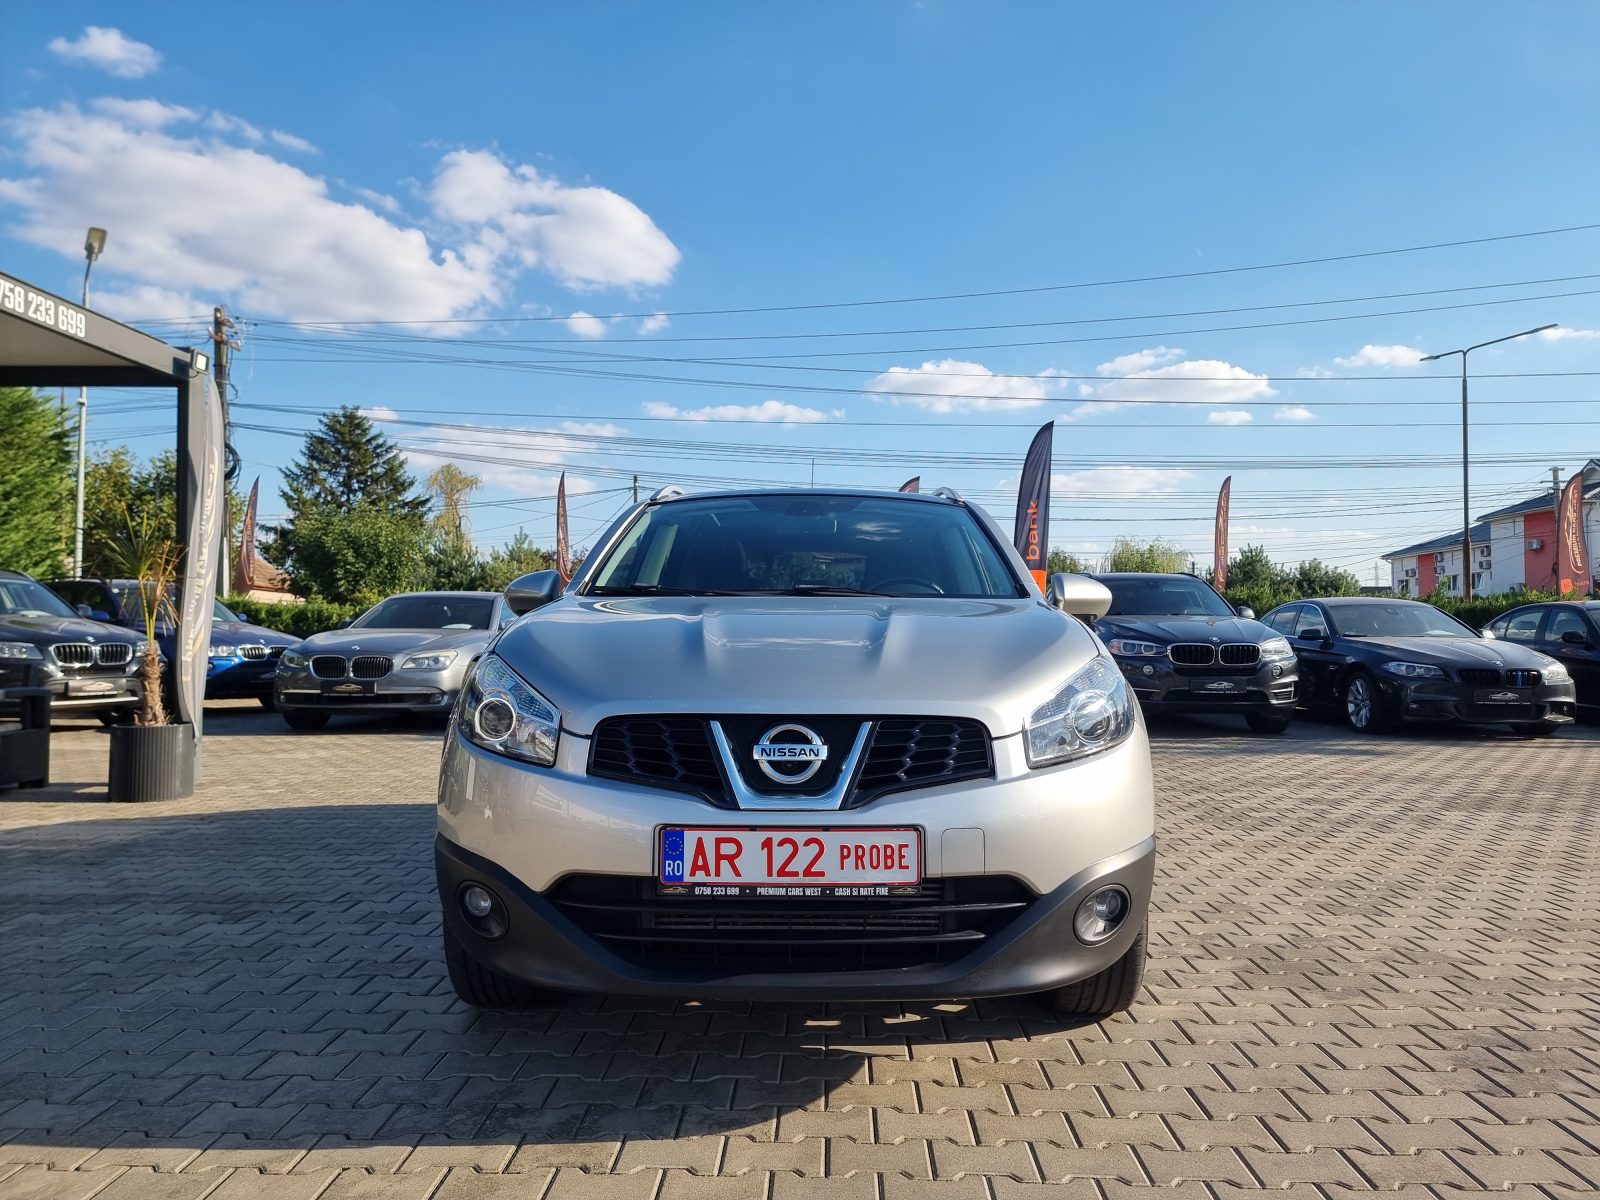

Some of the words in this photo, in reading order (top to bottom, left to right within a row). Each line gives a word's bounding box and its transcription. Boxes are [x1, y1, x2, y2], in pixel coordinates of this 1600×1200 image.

[28, 292, 55, 326] 233
[58, 305, 86, 338] 699
[1026, 499, 1040, 560] bank
[1572, 533, 1583, 567] PREMIUM
[760, 747, 820, 757] NISSAN
[689, 836, 743, 878] AR
[761, 836, 826, 878] 122
[839, 843, 910, 870] PROBE
[665, 860, 683, 876] RO
[694, 886, 711, 895] 0758
[712, 886, 726, 895] 233
[726, 886, 740, 895] 699
[756, 887, 787, 896] PREMIUM
[787, 887, 804, 896] CARS
[804, 887, 822, 896] WEST
[834, 887, 851, 896] CASH
[852, 887, 859, 896] SI
[859, 887, 875, 896] RATE
[875, 887, 889, 896] FIXE
